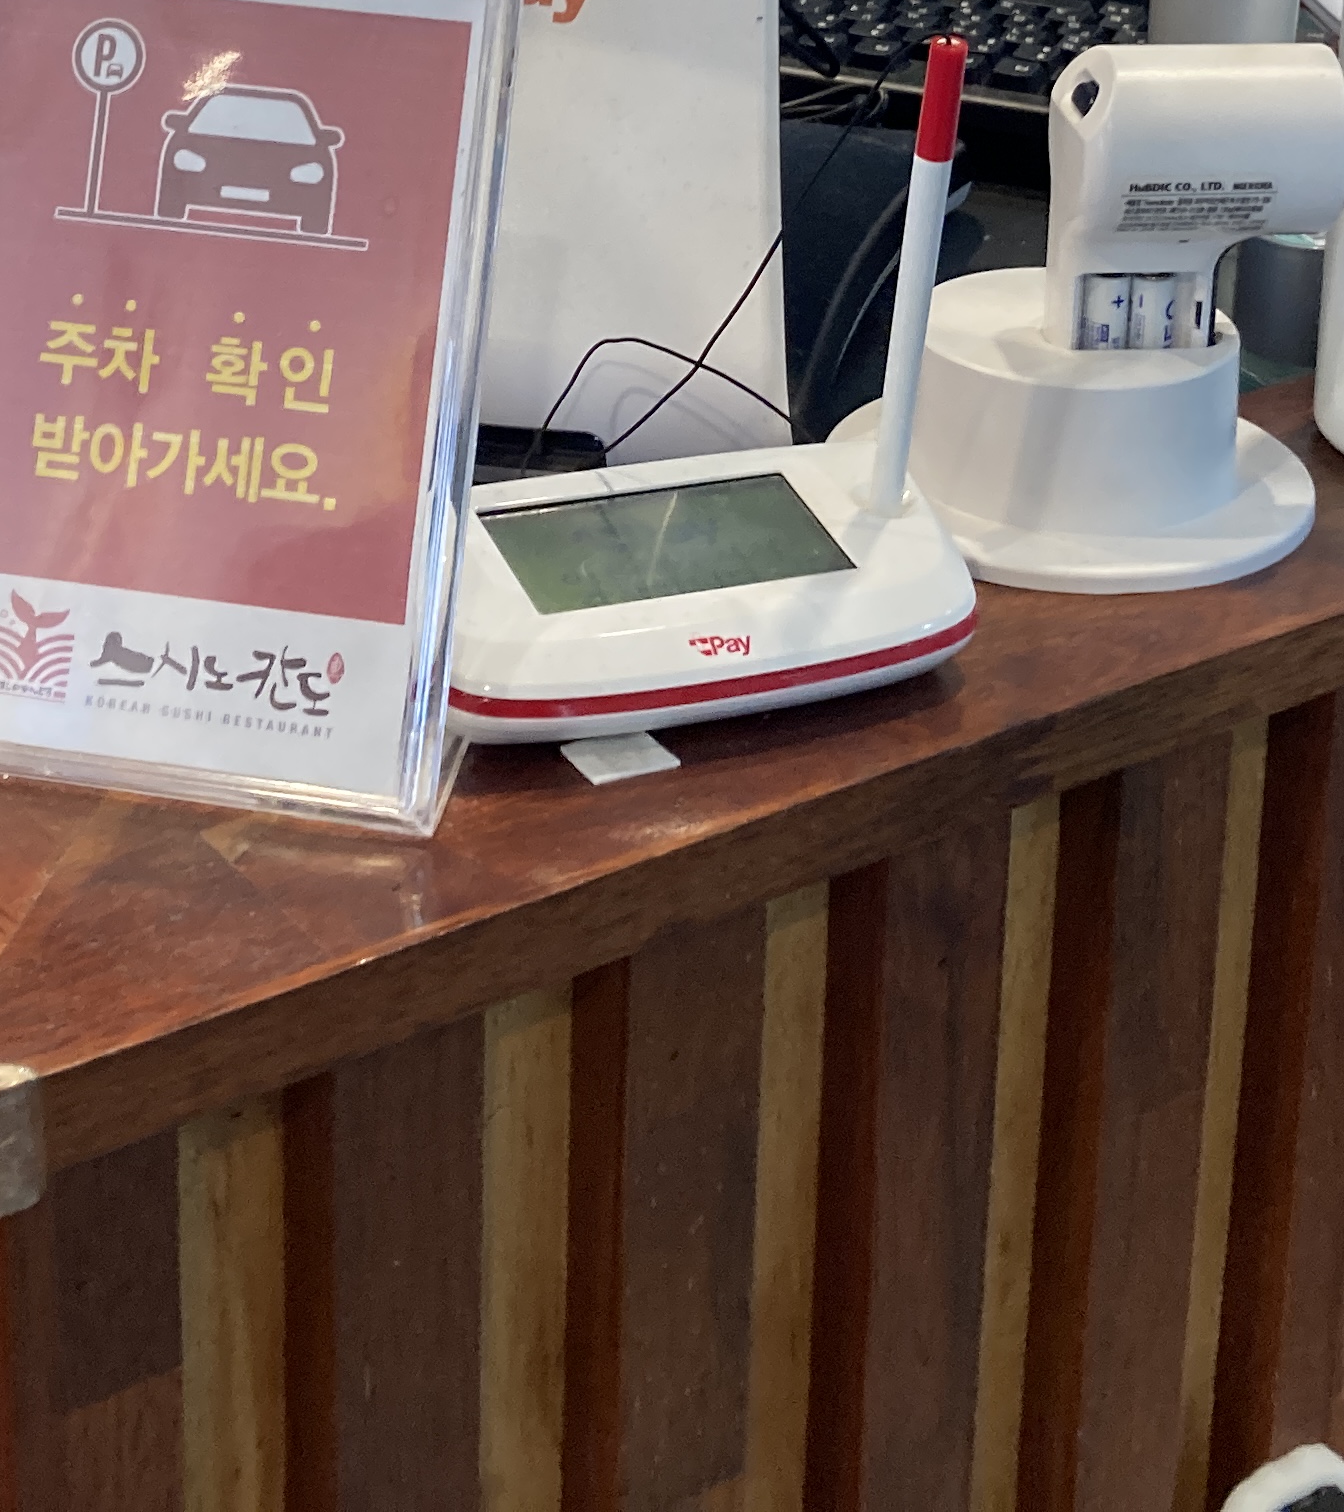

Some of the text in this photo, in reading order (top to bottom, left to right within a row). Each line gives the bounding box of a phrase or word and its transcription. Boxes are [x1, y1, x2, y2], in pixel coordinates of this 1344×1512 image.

[38, 318, 336, 415] 주차 확인
[30, 412, 338, 512] 받아가세요.
[84, 694, 152, 715] KOREAN
